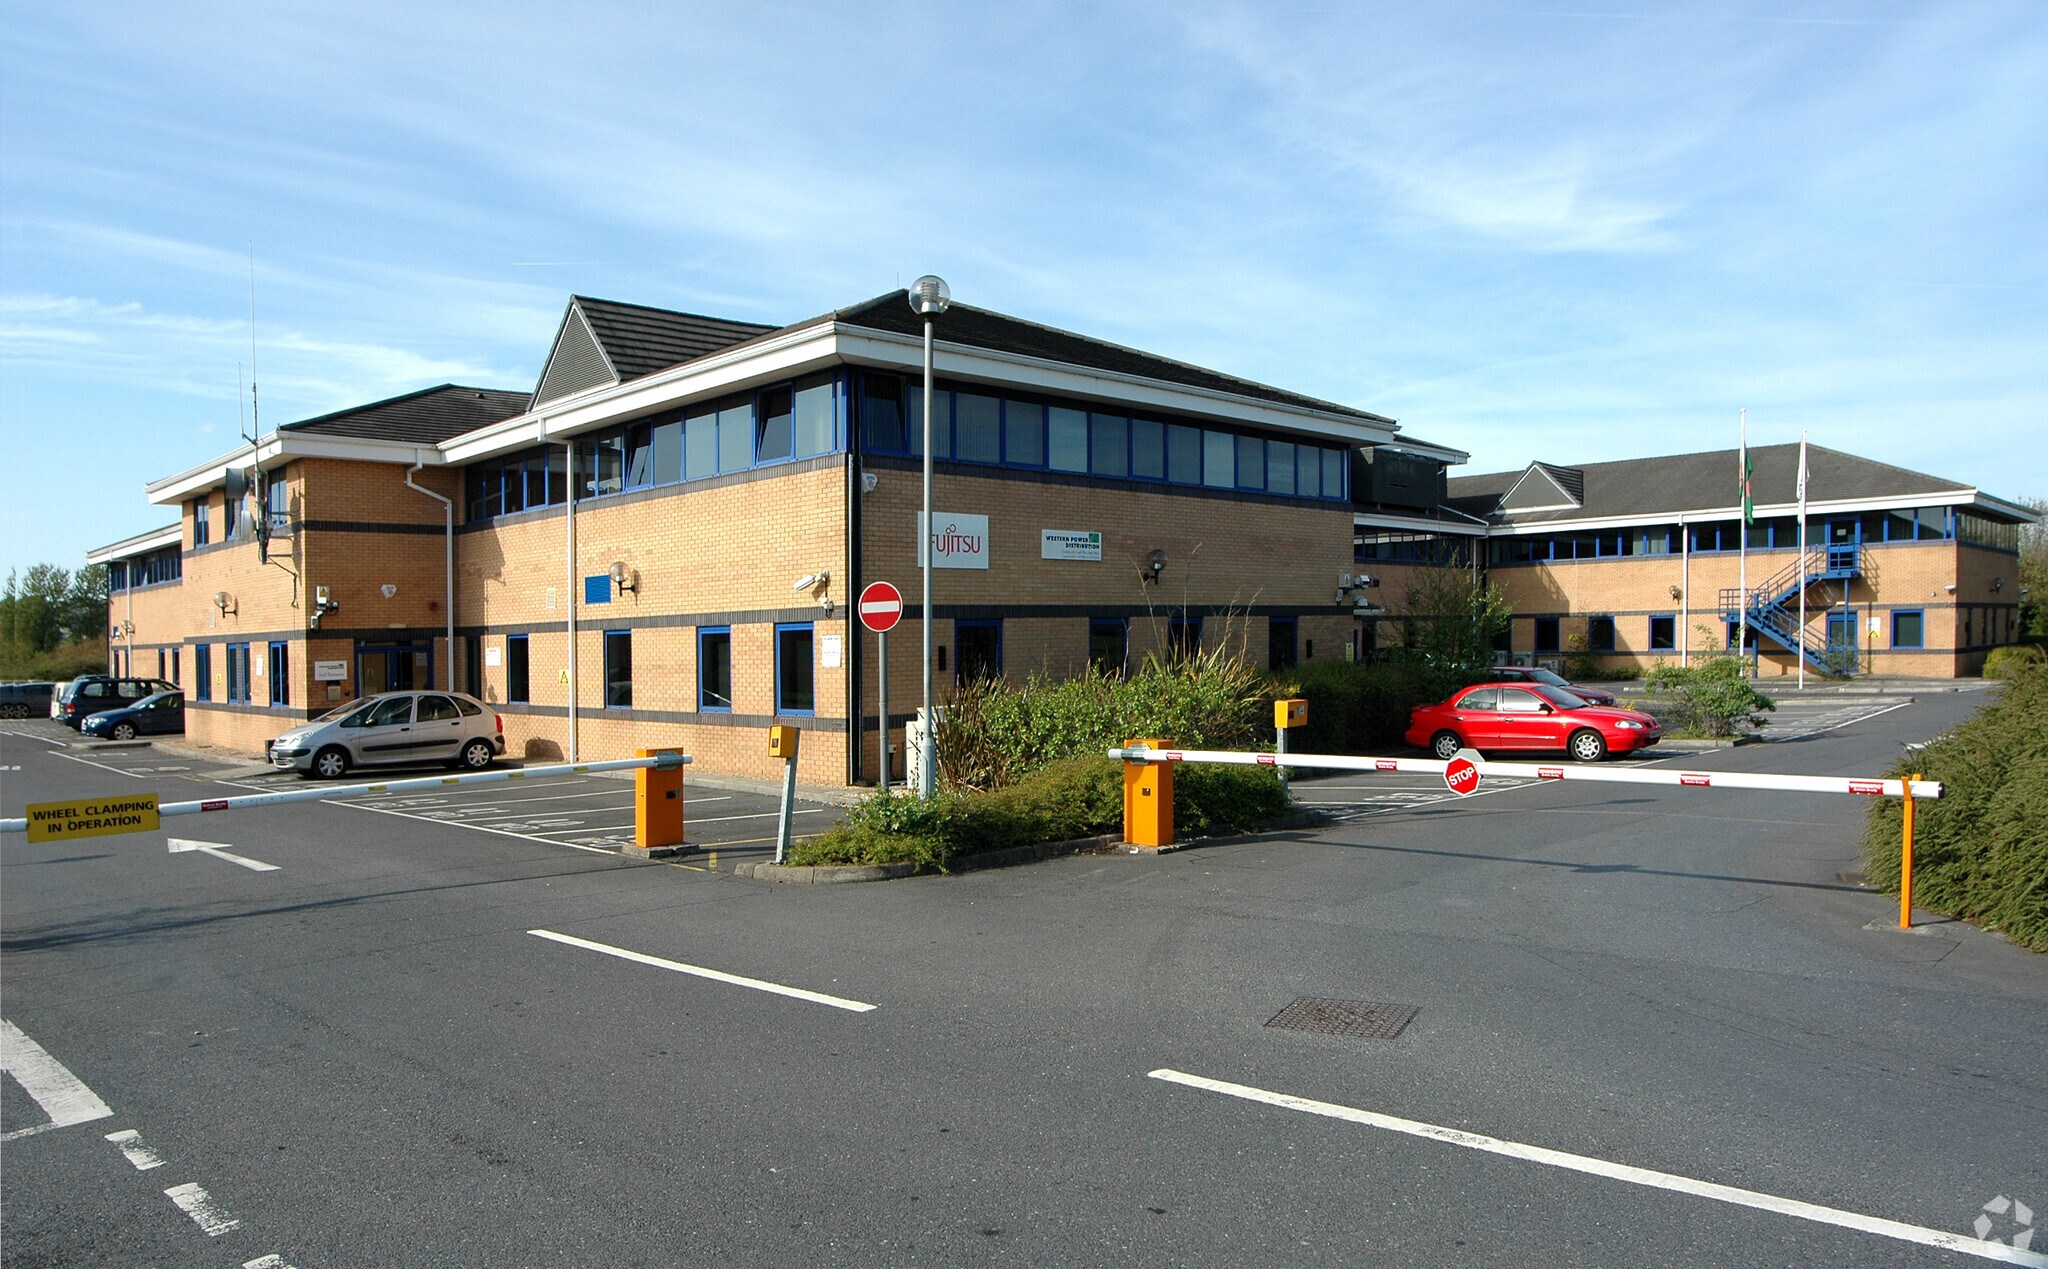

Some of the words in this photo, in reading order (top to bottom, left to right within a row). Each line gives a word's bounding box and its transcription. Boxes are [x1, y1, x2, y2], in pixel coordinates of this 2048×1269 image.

[932, 524, 981, 557] UJITSU
[1449, 767, 1475, 786] STOP
[33, 808, 80, 820] WHEEL
[85, 801, 154, 815] CLAMPING
[48, 823, 62, 833] IN
[68, 815, 141, 830] OPERATION
